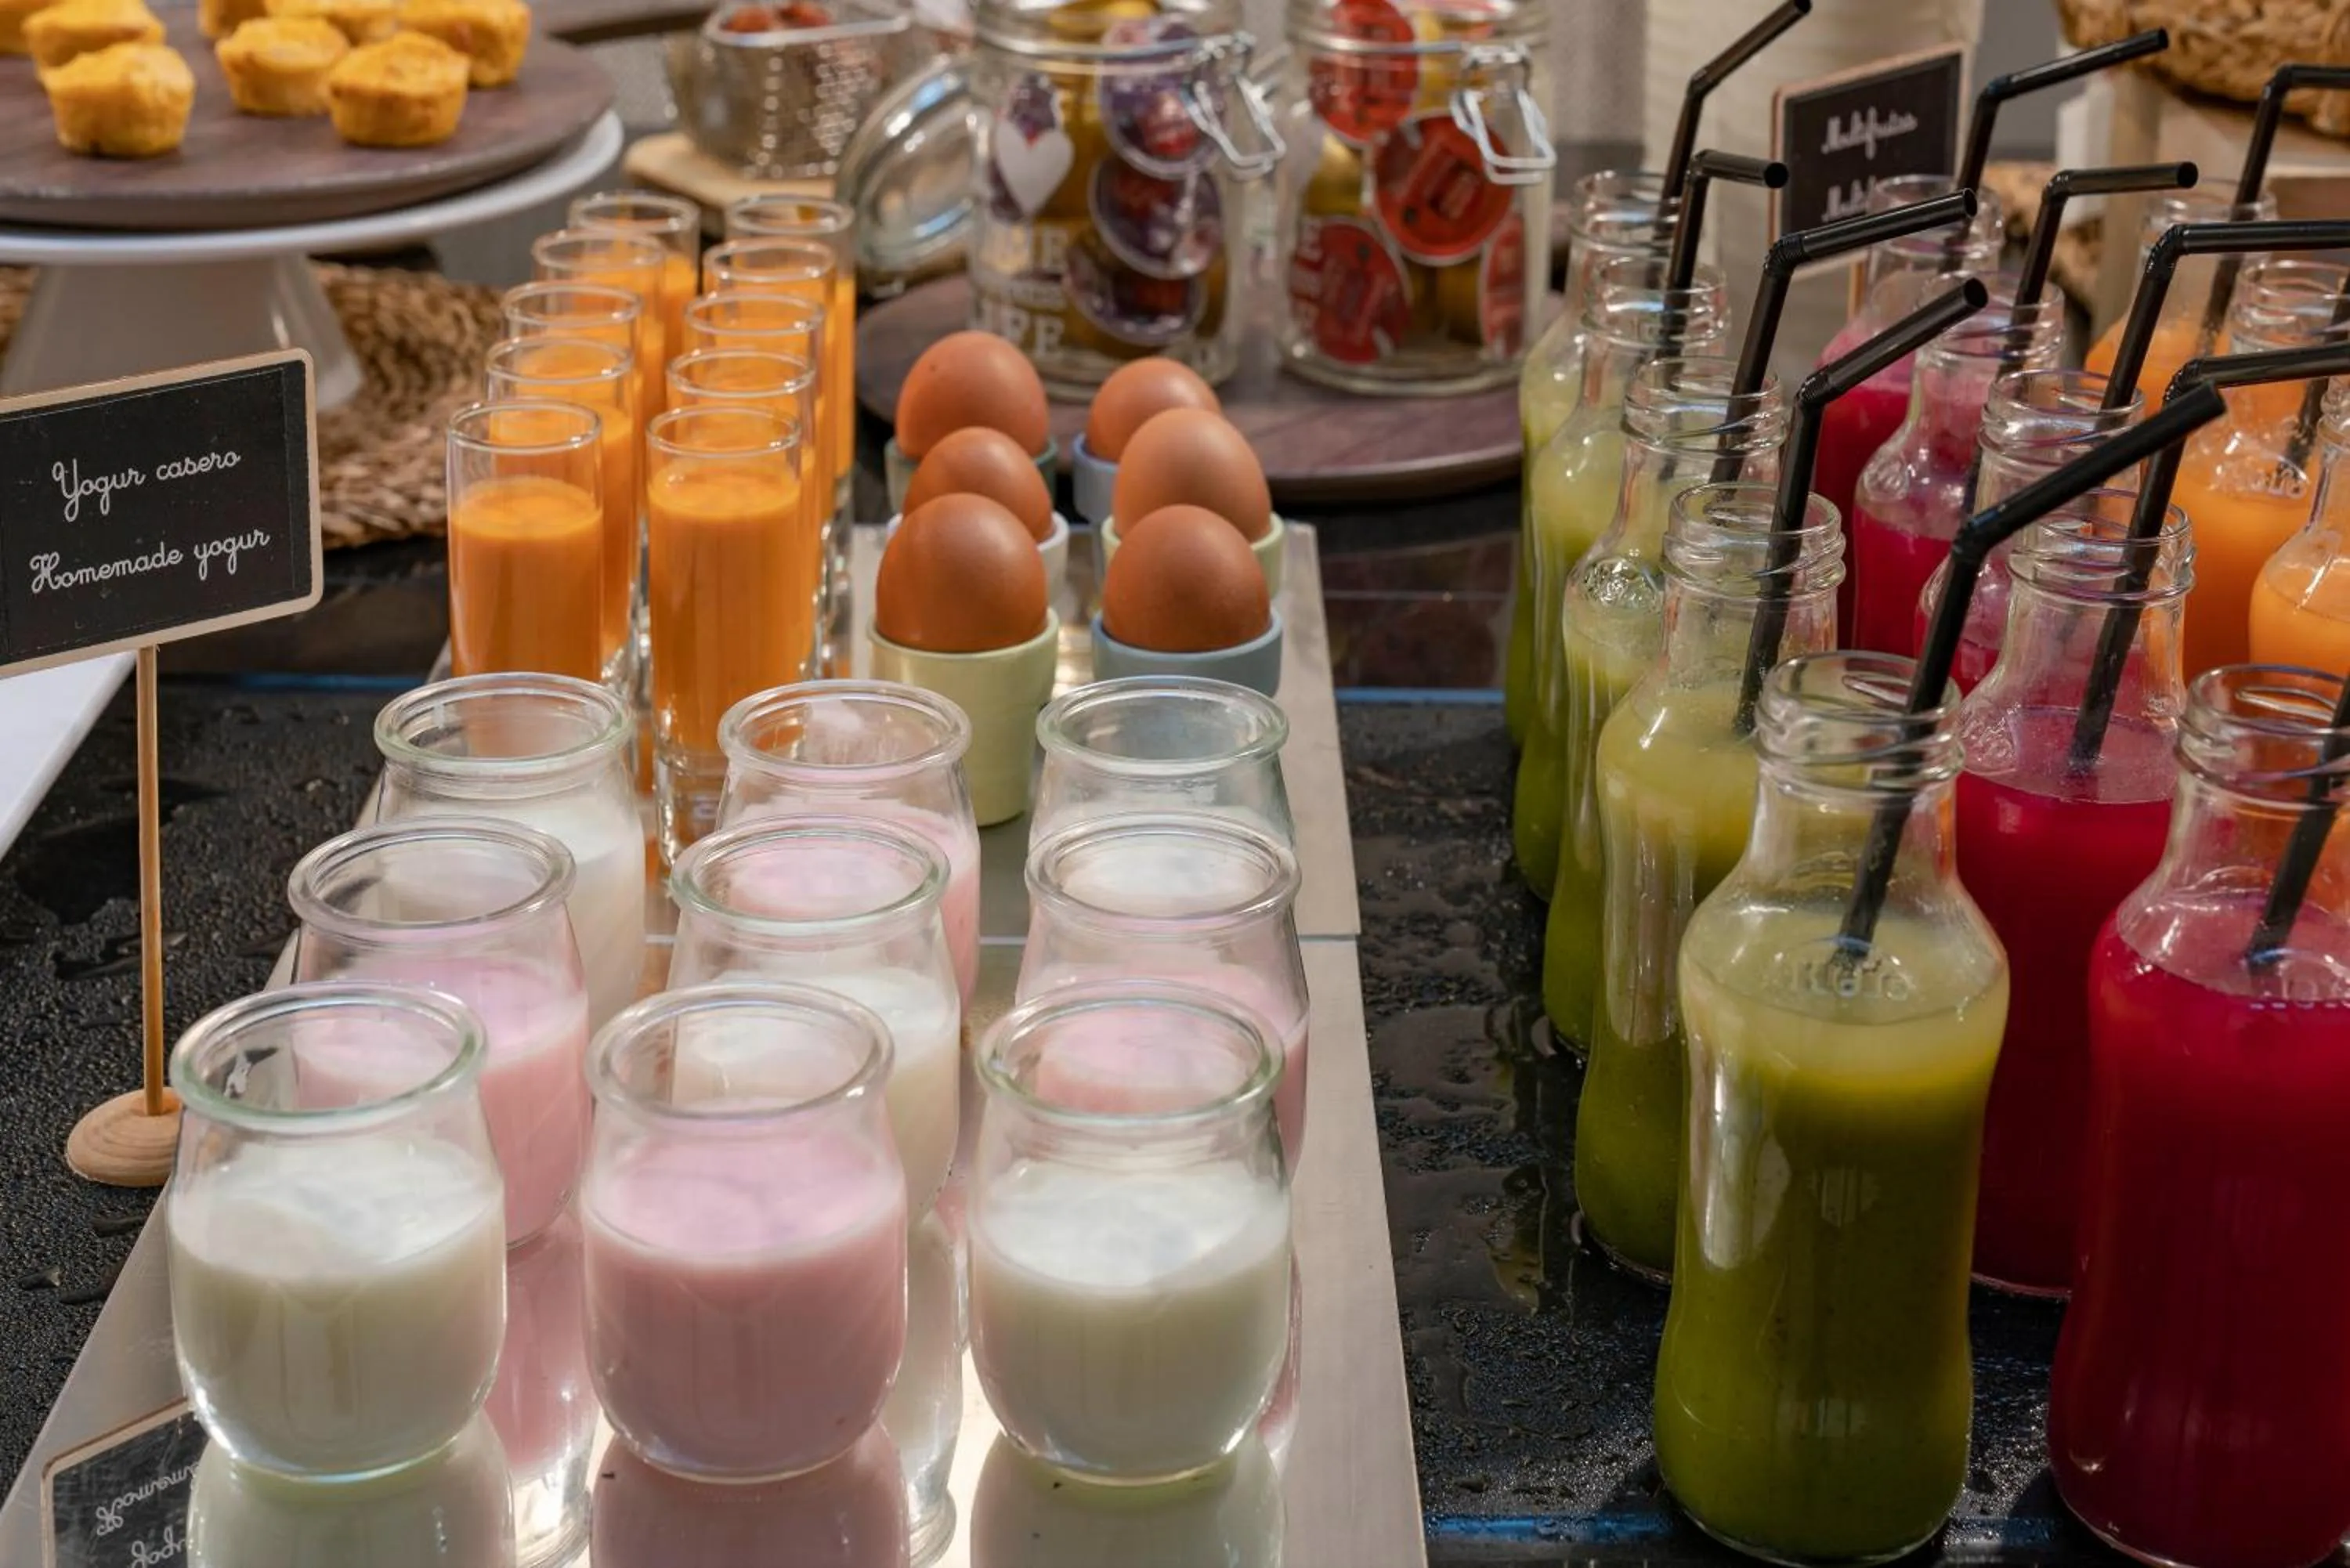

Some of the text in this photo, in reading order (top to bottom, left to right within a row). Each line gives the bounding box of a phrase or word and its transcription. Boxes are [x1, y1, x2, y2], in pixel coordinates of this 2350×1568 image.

[52, 450, 241, 522] Yogur casero
[29, 528, 270, 594] Homemade yogur
